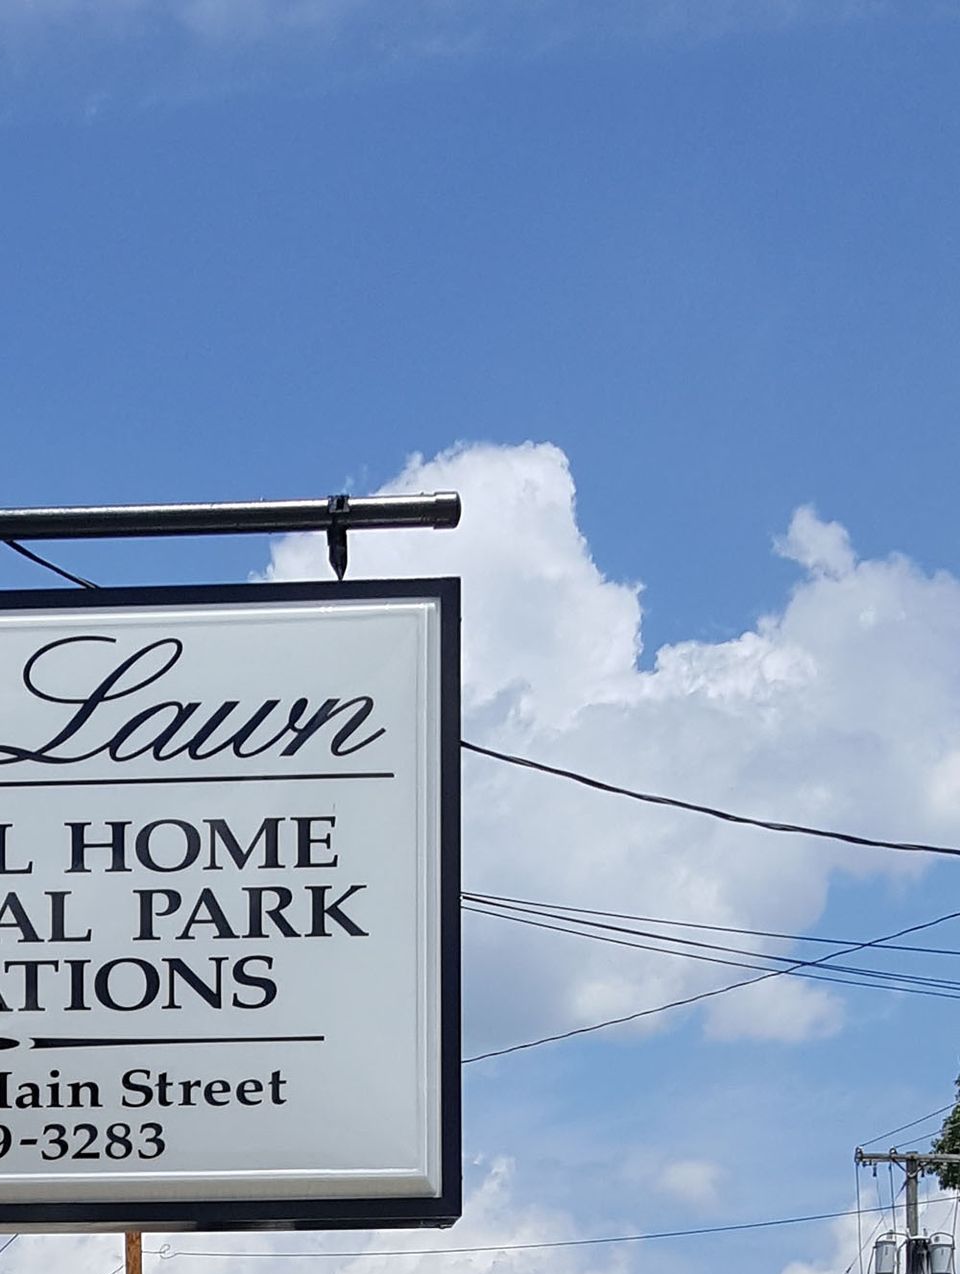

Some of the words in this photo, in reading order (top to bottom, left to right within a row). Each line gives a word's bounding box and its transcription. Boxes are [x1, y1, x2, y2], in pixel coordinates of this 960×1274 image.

[64, 815, 339, 874] HOME
[132, 884, 370, 942] PARK
[121, 1068, 287, 1108] Street
